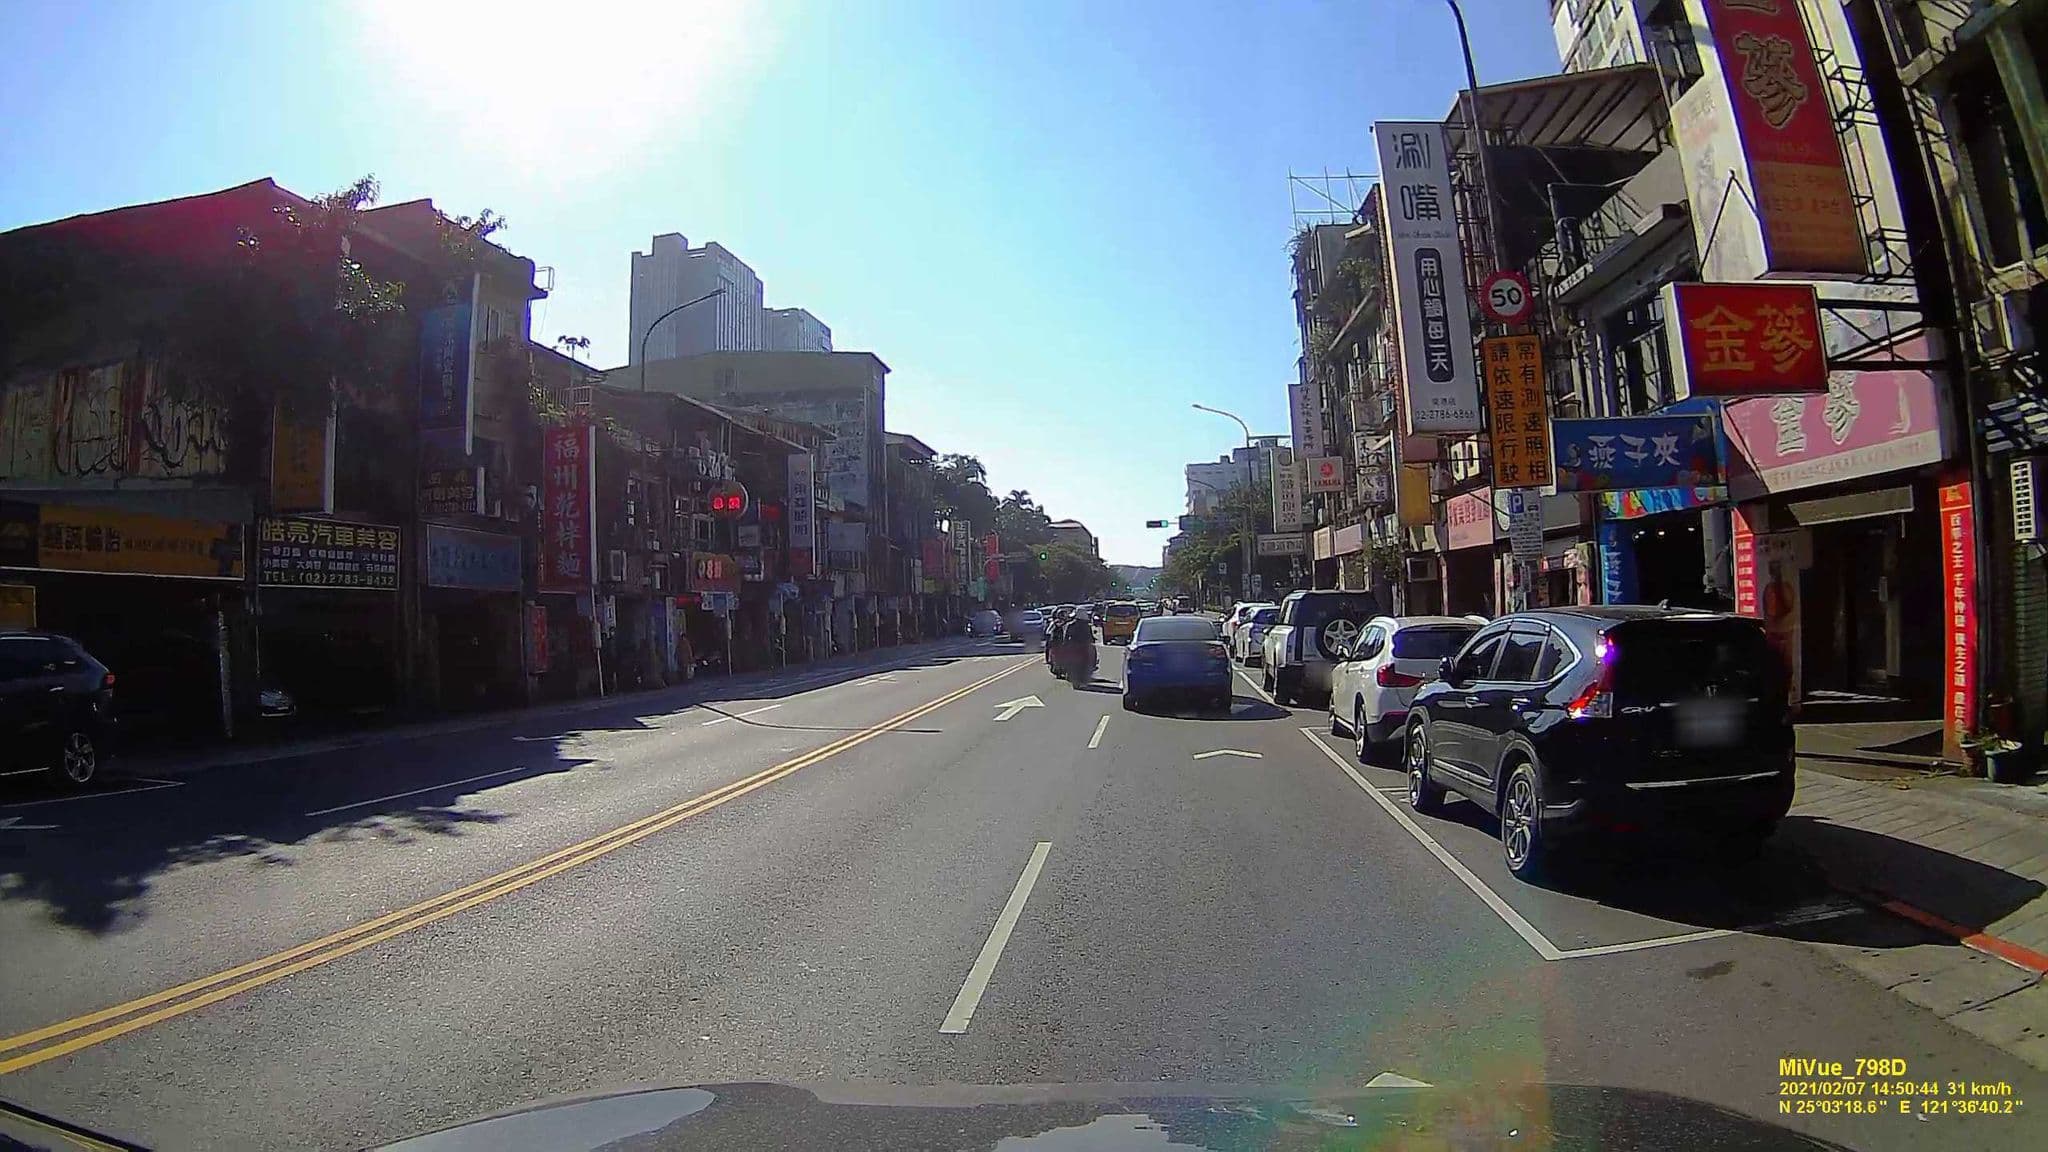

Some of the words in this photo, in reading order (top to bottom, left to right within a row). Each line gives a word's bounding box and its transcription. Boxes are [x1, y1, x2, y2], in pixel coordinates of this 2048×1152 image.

[1392, 132, 1442, 222] 涮嘴
[1491, 286, 1522, 308] 50
[1490, 343, 1520, 483] 請依速限行駛
[1515, 340, 1548, 481] 常有測速照相
[1587, 431, 1681, 469] 燕子夾
